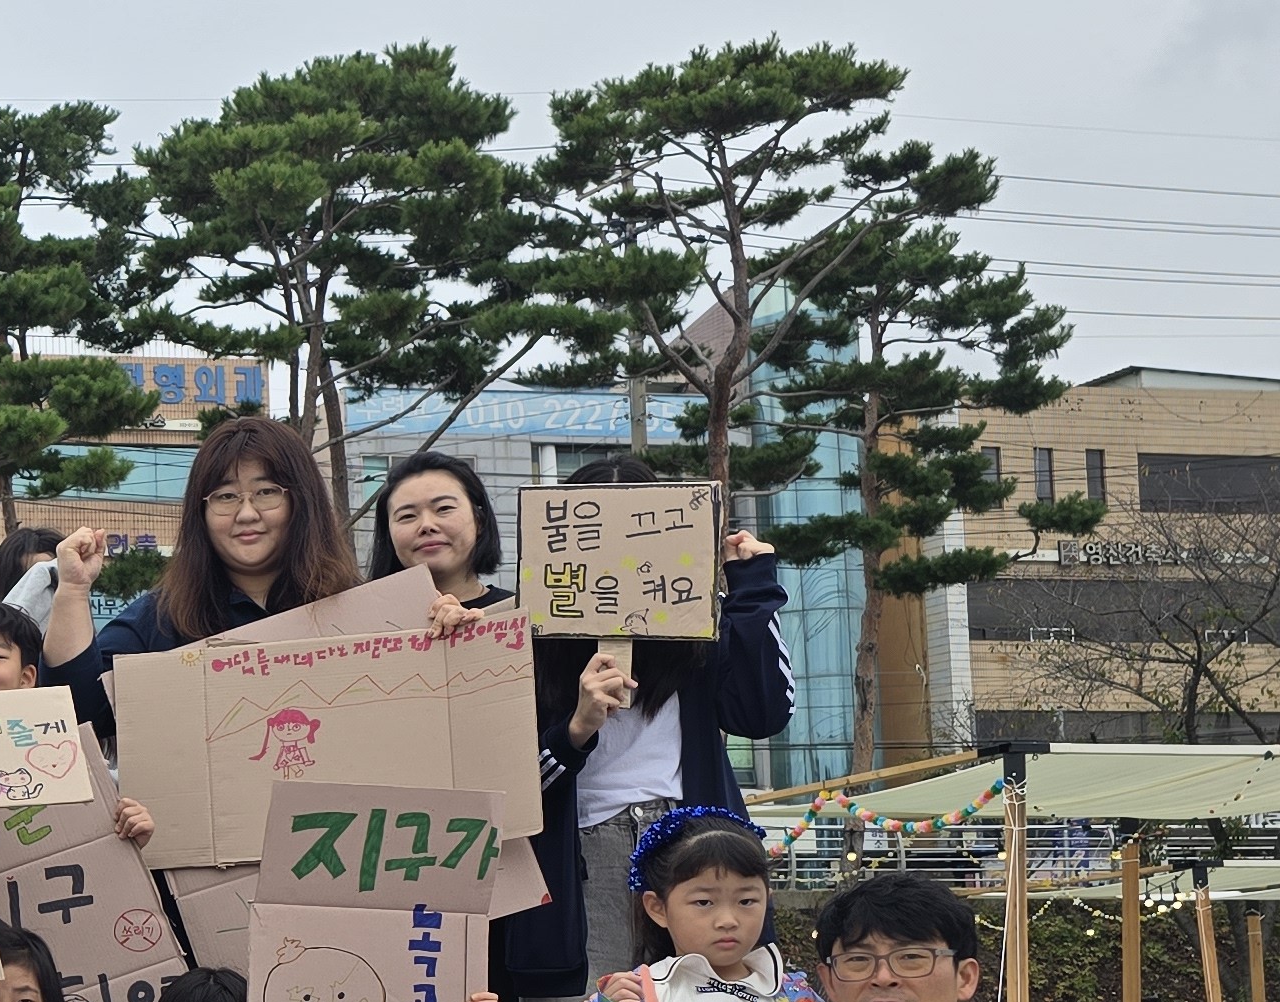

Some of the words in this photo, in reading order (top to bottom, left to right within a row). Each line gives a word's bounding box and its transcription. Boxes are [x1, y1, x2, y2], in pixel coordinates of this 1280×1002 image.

[542, 498, 603, 553] 불을
[626, 508, 694, 538] 끄고
[544, 562, 620, 618] 별을
[642, 574, 702, 605] 켜요
[290, 808, 500, 892] 지구가
